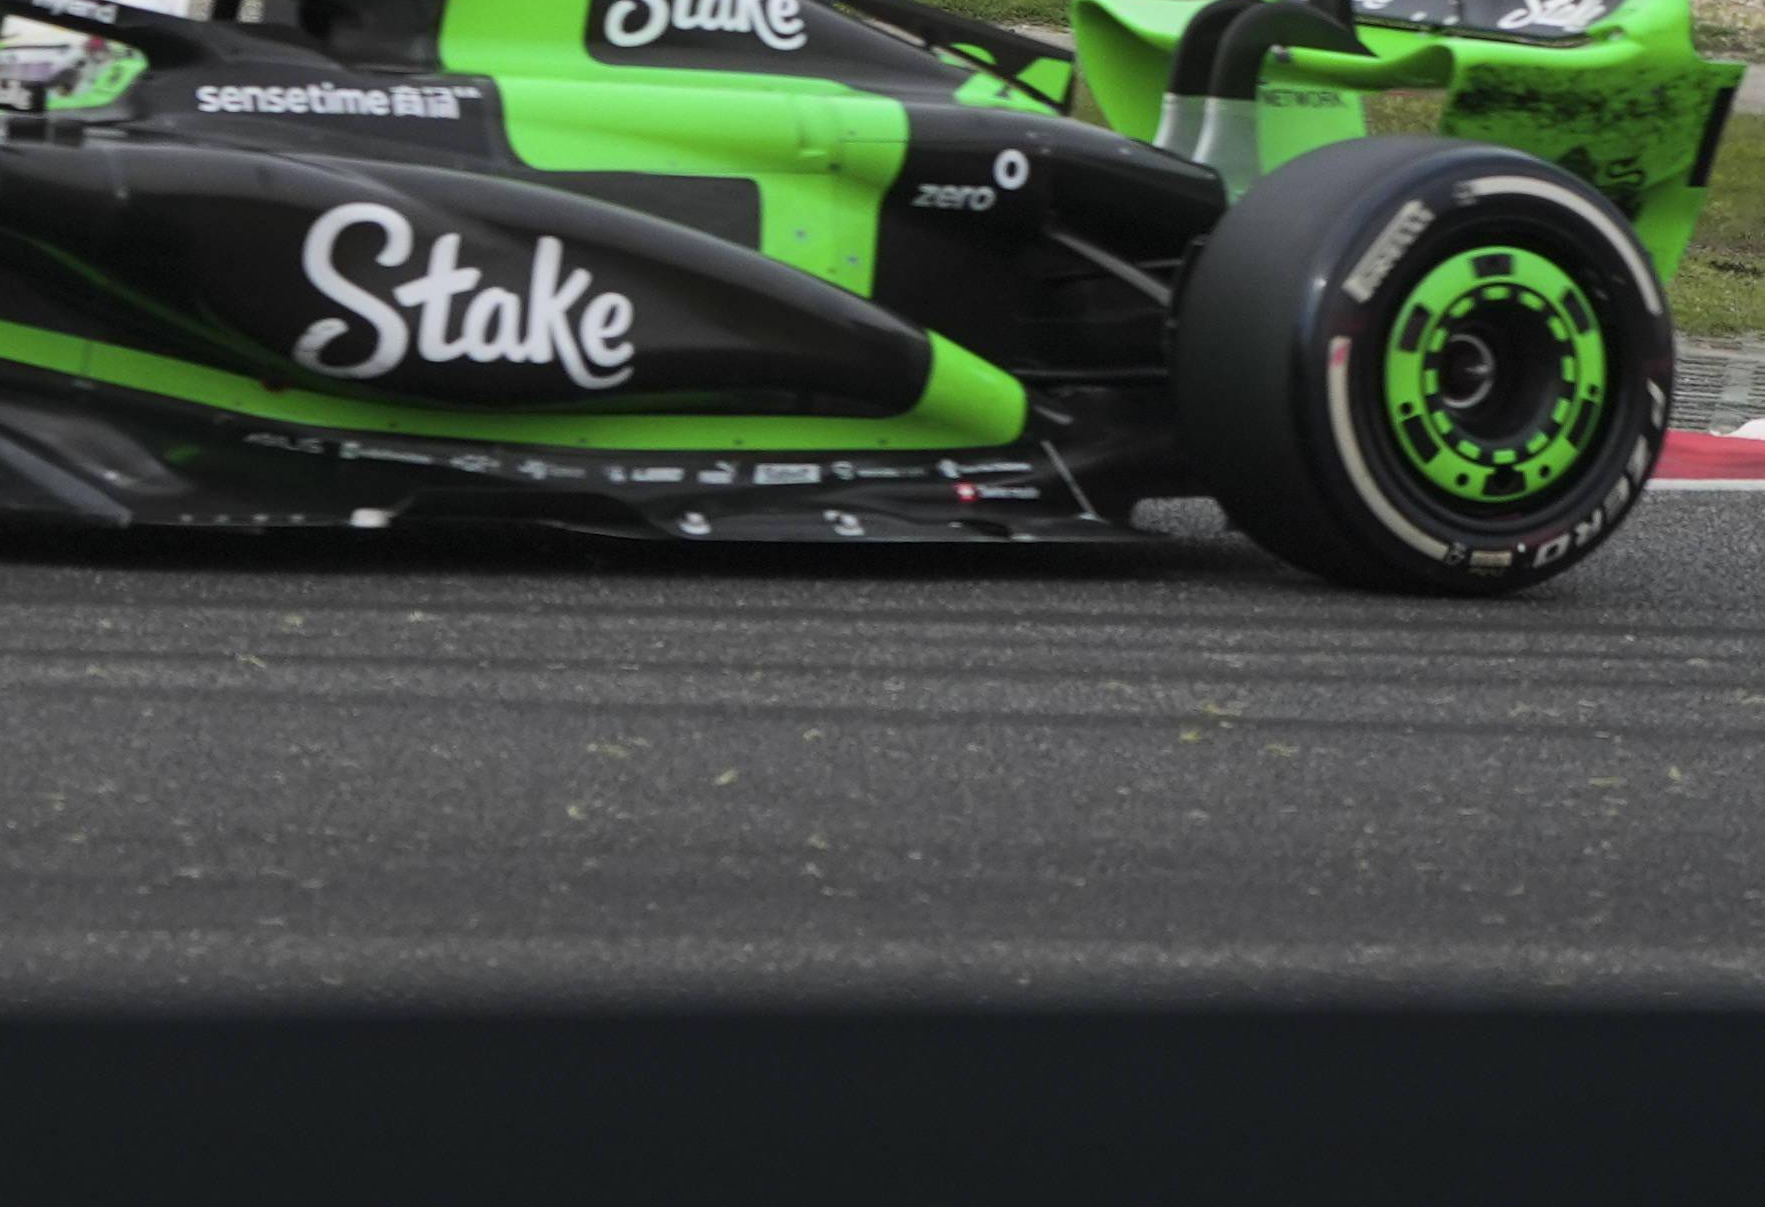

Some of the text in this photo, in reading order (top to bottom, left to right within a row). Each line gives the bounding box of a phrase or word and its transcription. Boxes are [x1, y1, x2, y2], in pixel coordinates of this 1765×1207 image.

[195, 80, 390, 116] sensetime
[912, 182, 997, 212] zero
[293, 201, 636, 389] Stake
